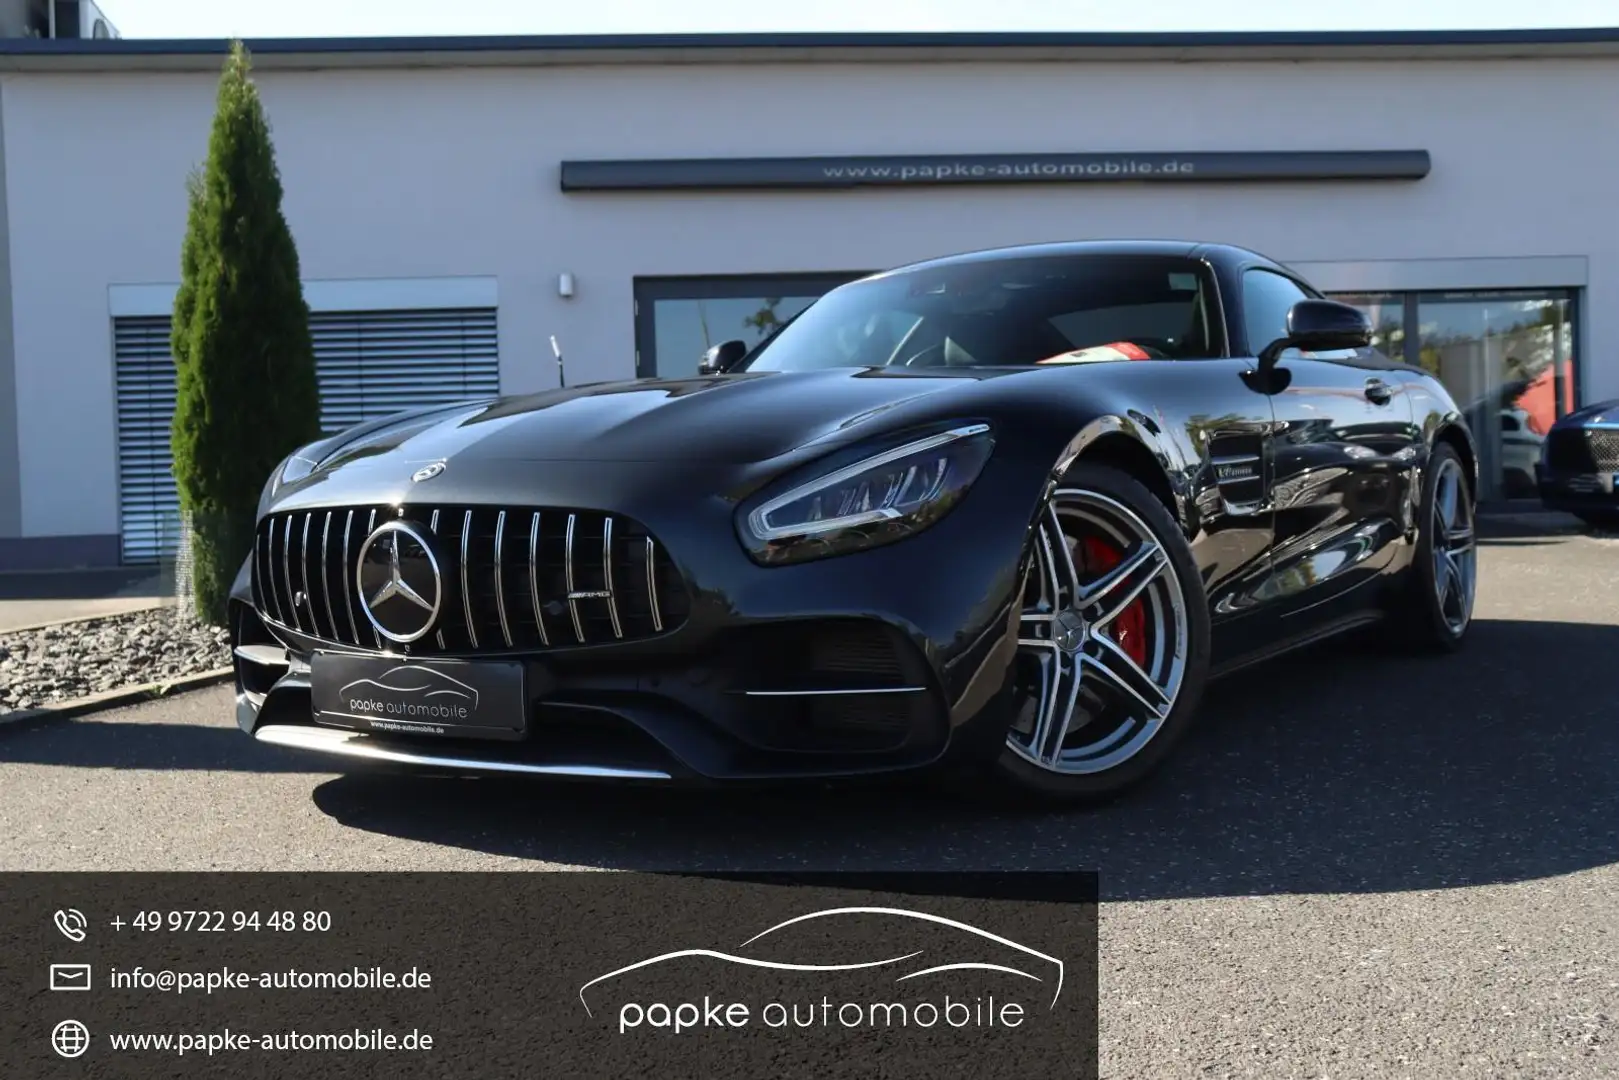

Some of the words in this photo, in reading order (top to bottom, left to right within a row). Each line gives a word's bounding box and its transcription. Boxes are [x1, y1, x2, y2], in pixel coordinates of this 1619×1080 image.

[823, 159, 1195, 179] www.papke-automobile.de
[350, 699, 384, 712] papke
[386, 702, 468, 718] automobile
[370, 721, 445, 734] www.papke-automobile.de
